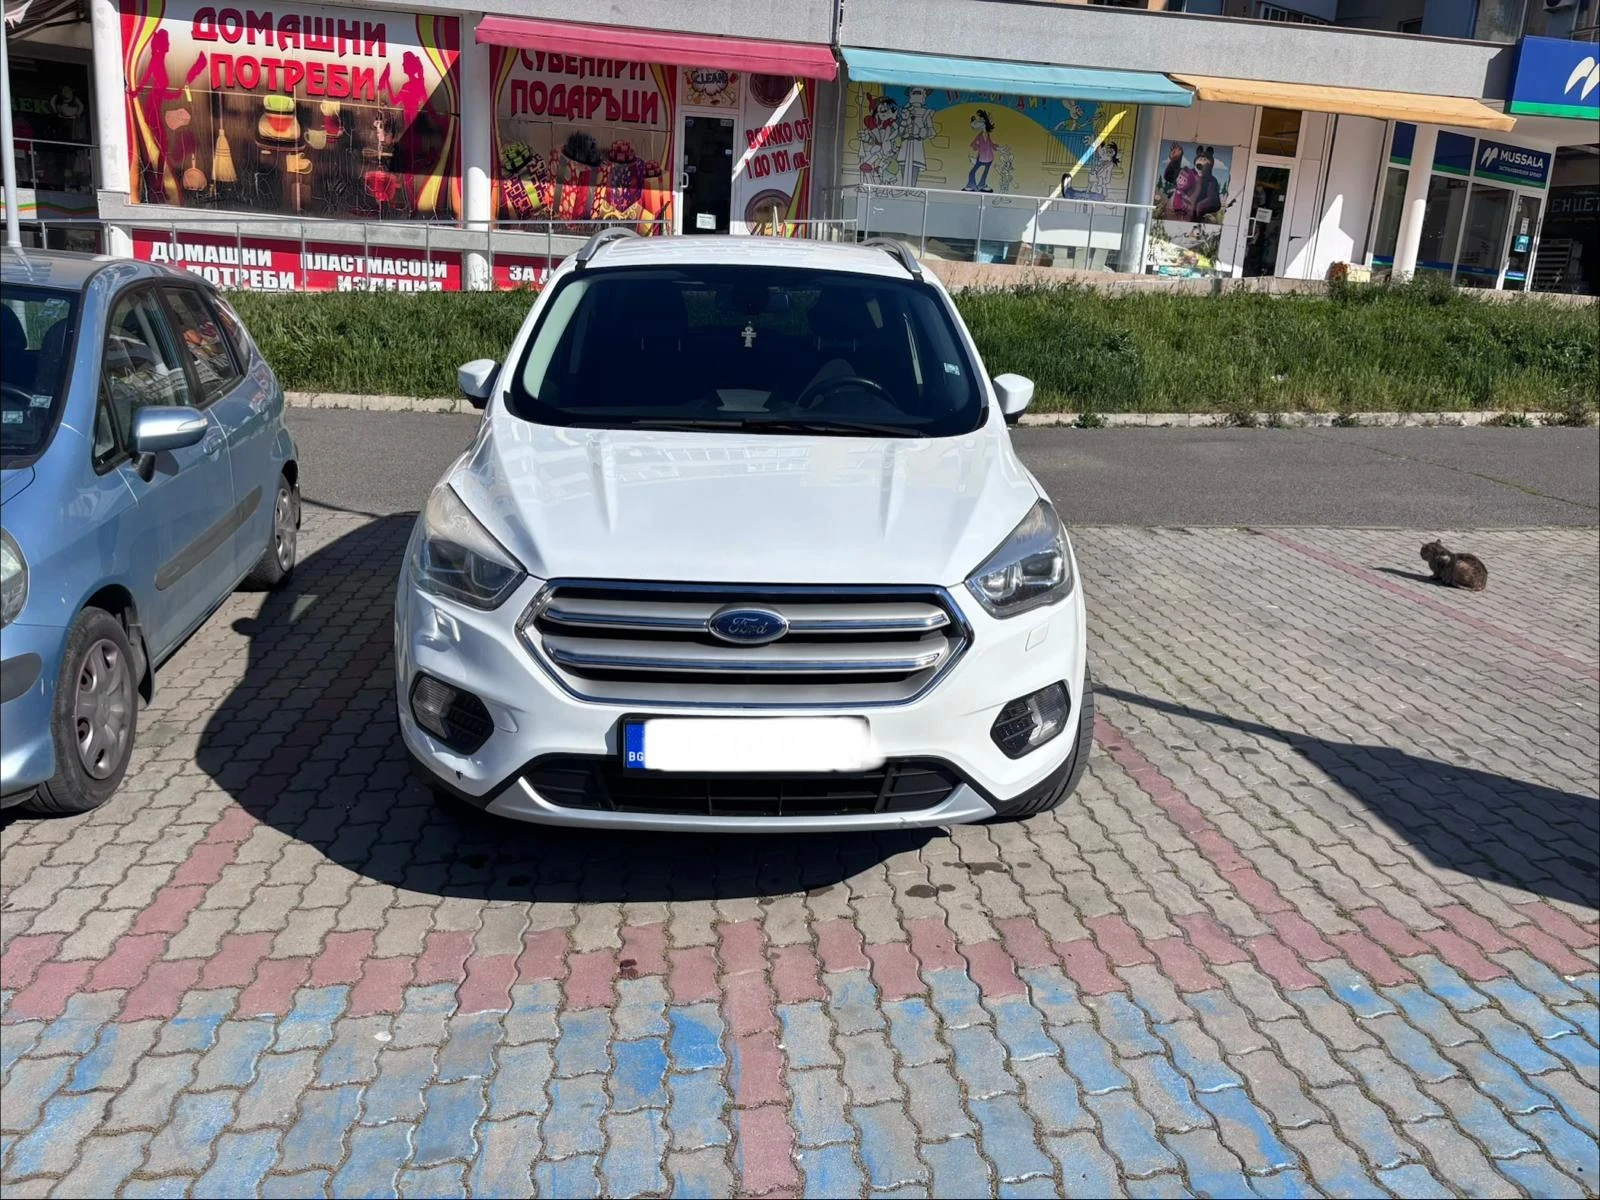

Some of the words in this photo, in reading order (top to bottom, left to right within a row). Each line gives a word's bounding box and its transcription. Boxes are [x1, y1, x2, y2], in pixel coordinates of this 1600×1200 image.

[191, 7, 387, 58] ДОМАШНИ
[210, 53, 376, 101] ПОТРЕБИ
[511, 79, 658, 125] ПОДАРЪЦИ
[745, 122, 793, 150] ВСИЧКО
[794, 118, 813, 141] ОТ
[754, 154, 771, 178] ДО
[771, 149, 791, 174] 101
[1500, 150, 1544, 169] MUSSALA
[150, 241, 272, 267] ДОМАШНИ
[300, 251, 448, 279] ПЛАСТМАСОВИ
[185, 264, 295, 290] ПОТРЕБИ
[509, 265, 536, 281] ЗА
[728, 617, 768, 634] Ford
[628, 751, 645, 762] BG
